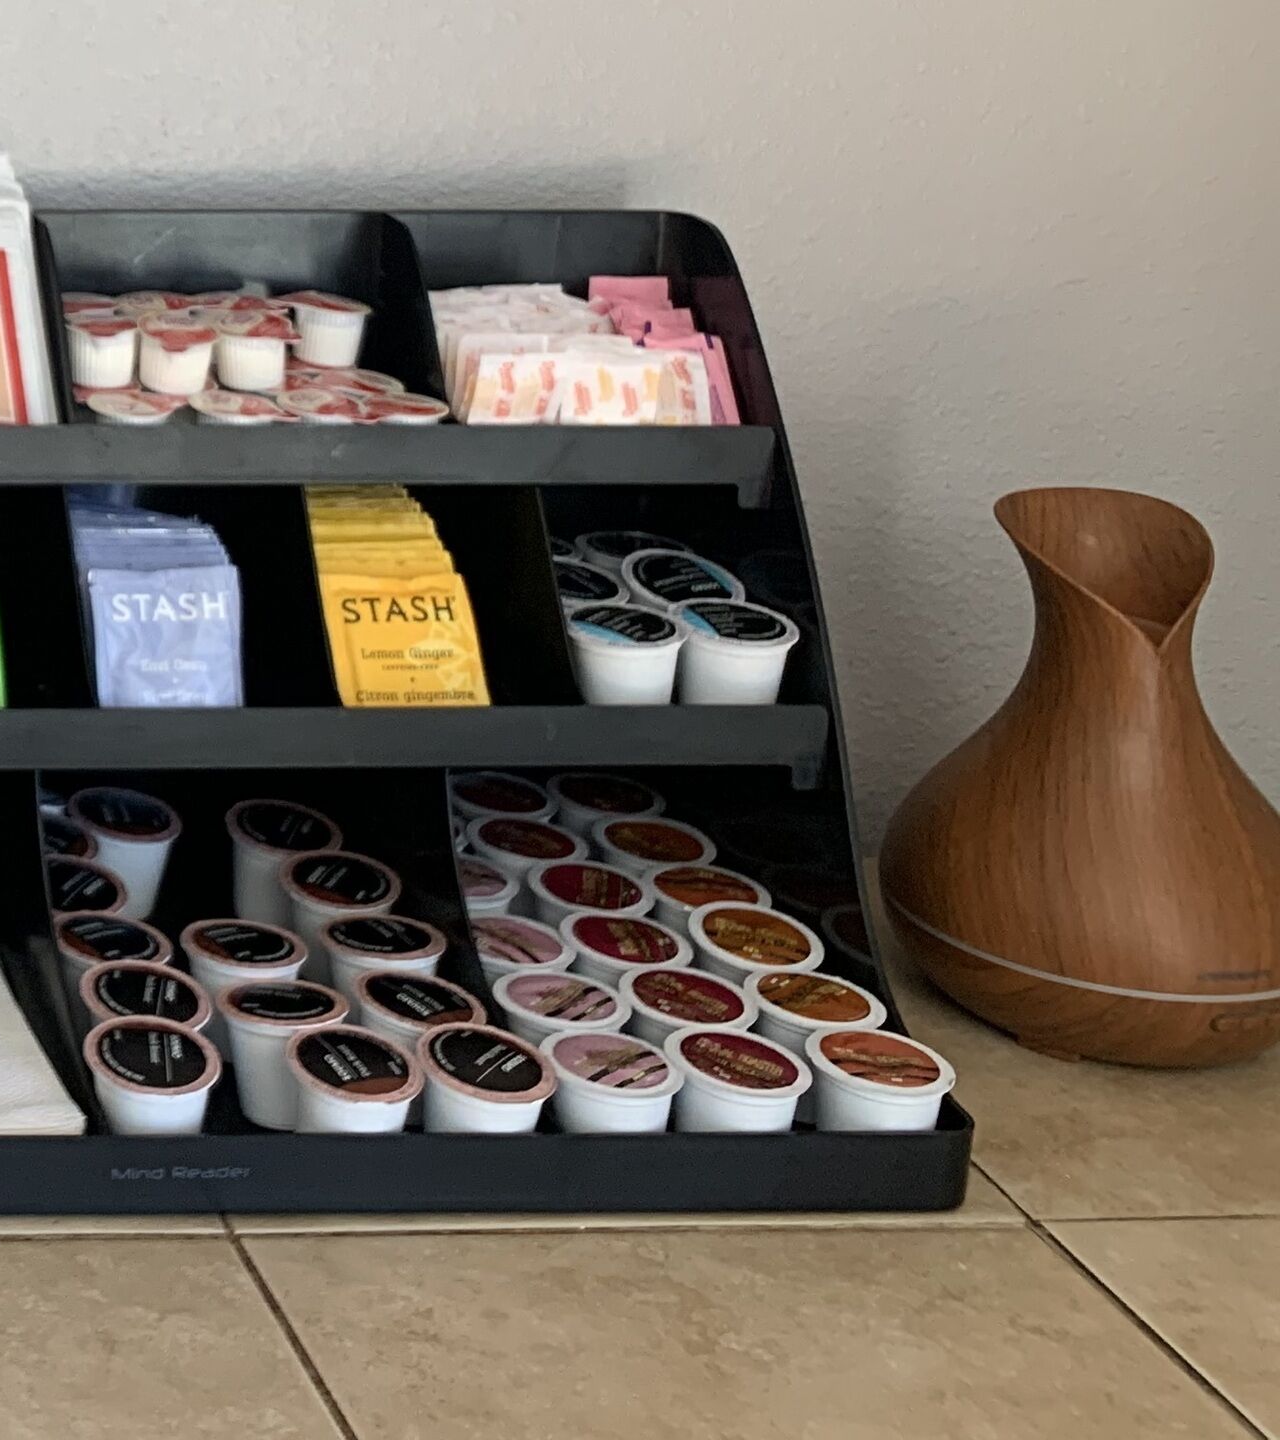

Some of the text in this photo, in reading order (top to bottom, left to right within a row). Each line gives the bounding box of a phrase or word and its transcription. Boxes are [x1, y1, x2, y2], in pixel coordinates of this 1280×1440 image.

[111, 591, 226, 622] STASH
[341, 595, 454, 624] STASH
[361, 647, 454, 662] Lemon Ginger
[356, 690, 399, 703] Citron
[111, 1166, 251, 1180] Mind Reader
